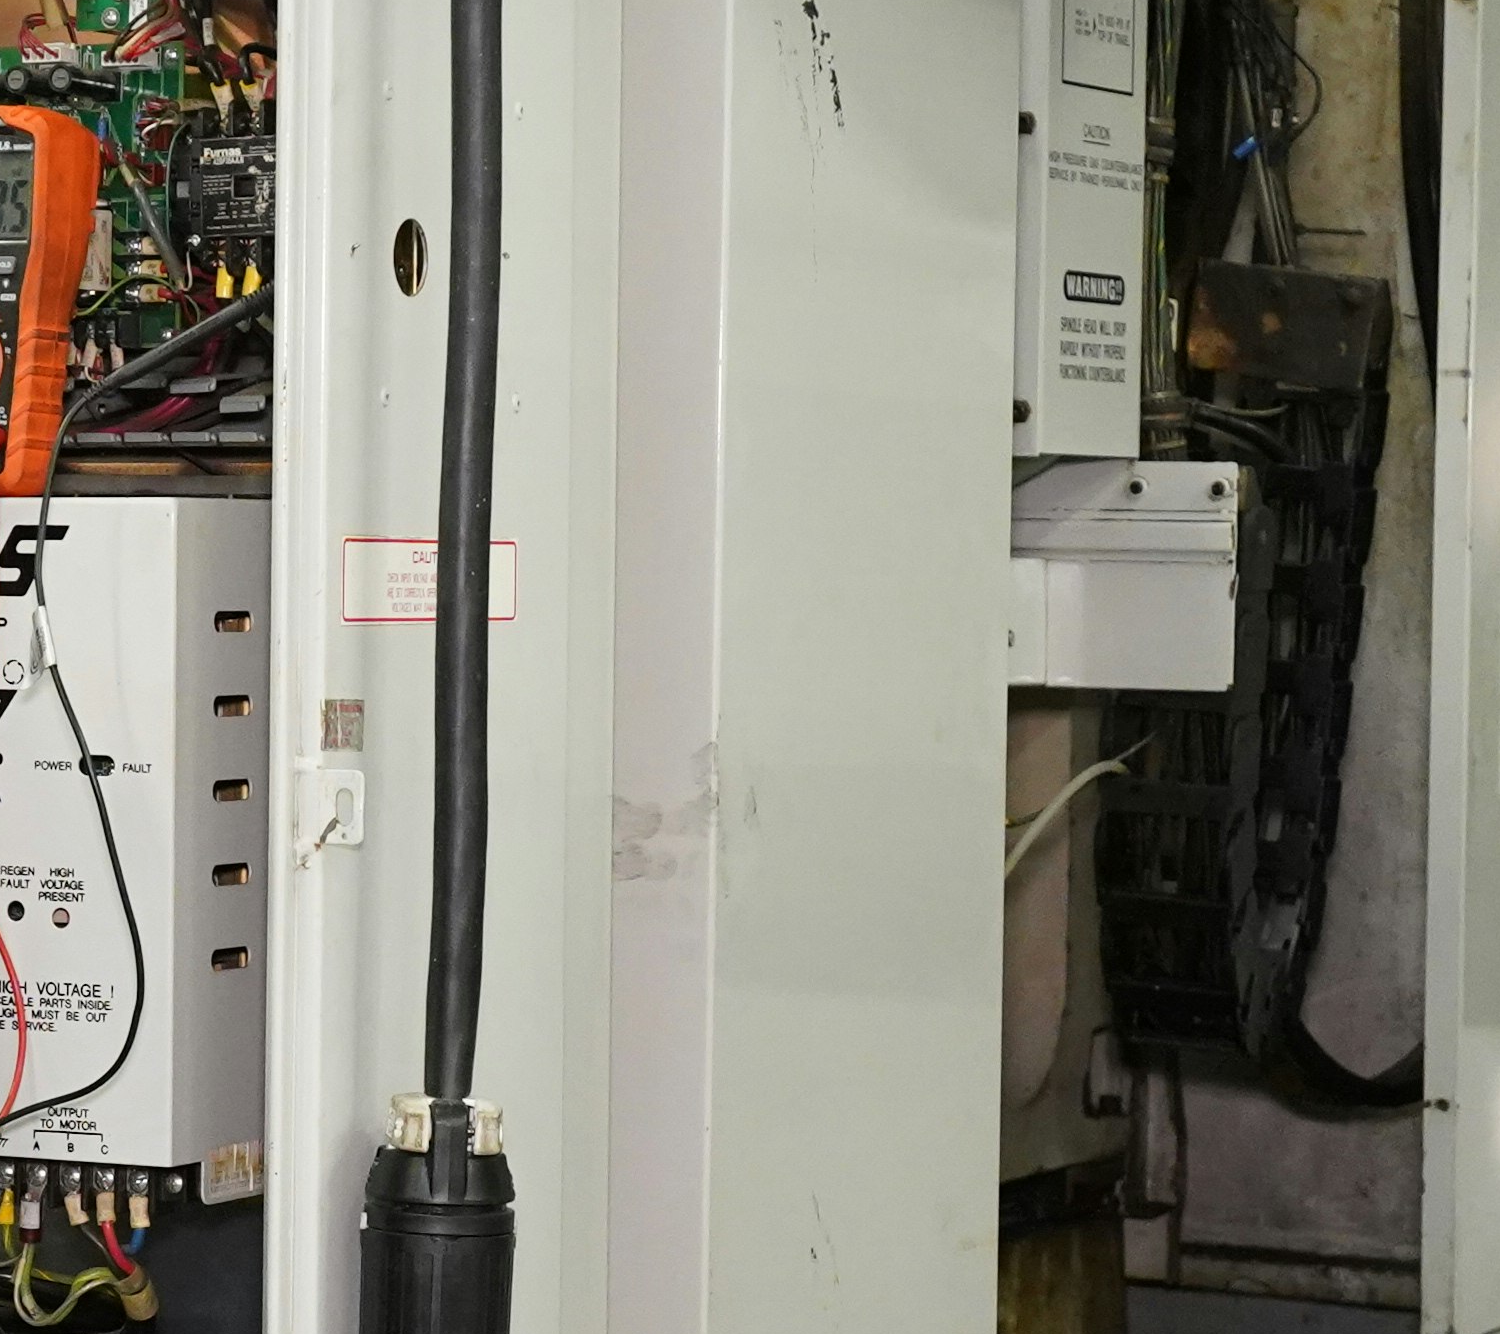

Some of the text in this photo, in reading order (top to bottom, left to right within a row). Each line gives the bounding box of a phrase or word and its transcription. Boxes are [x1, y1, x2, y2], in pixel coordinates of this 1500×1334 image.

[34, 760, 72, 772] POWER
[122, 763, 152, 774] FAULT
[0, 866, 35, 877] REGEN
[50, 867, 75, 879] HIGH
[0, 879, 31, 890] FAULT
[39, 880, 84, 891] VOLTAGE
[38, 892, 86, 903] PRESENT
[36, 982, 102, 998] VOLTAGE
[39, 997, 72, 1009] PARTS
[77, 998, 113, 1011] INSIDE.
[32, 1009, 60, 1020] MUST
[66, 1010, 80, 1021] BE
[85, 1012, 108, 1023] OUT
[11, 1020, 58, 1033] SRVICE.
[47, 1107, 89, 1119] OUTPUT
[40, 1119, 97, 1131] TO MOTOR
